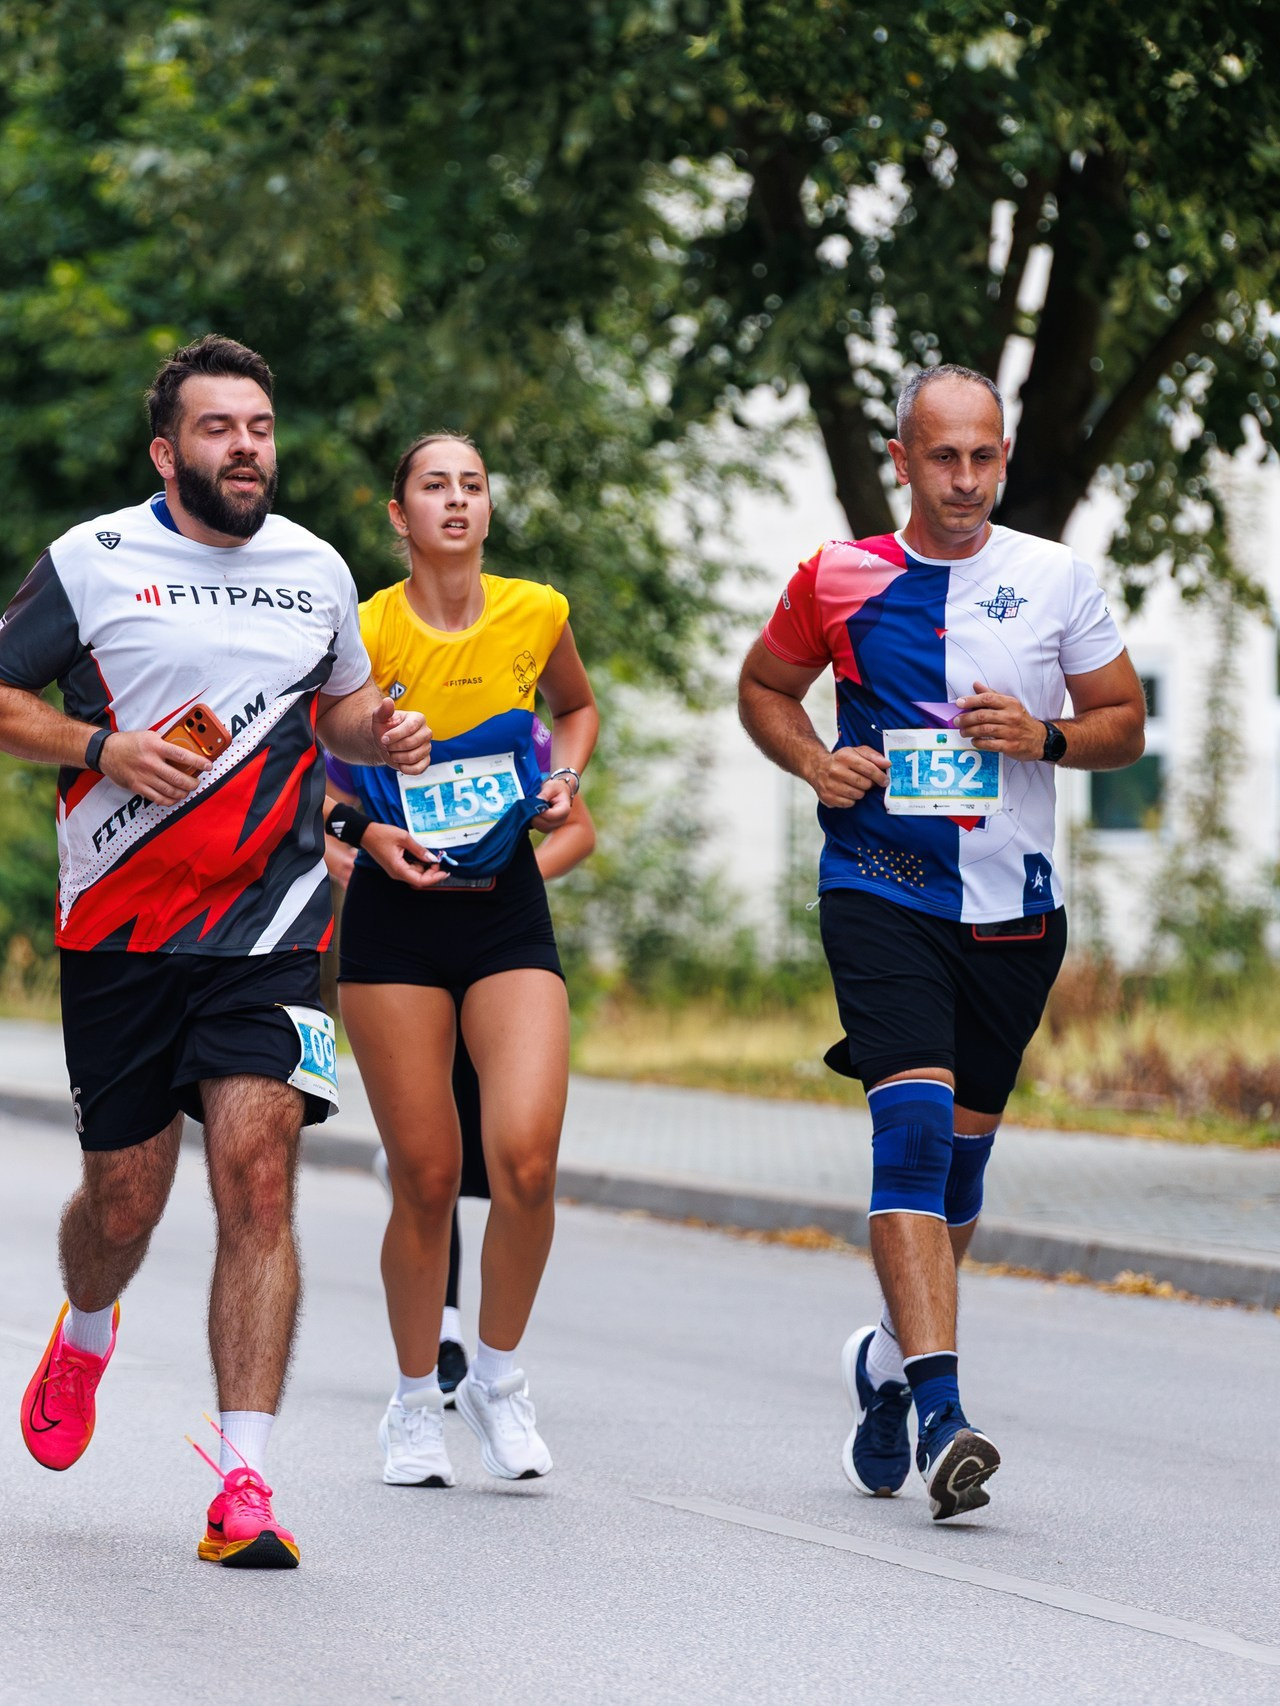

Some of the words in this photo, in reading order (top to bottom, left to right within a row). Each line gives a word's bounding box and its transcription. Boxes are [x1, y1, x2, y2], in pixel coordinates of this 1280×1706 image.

[166, 584, 314, 614] FITPASS
[449, 676, 483, 688] FITPASS
[904, 750, 984, 789] 152
[424, 775, 505, 822] 153
[91, 791, 154, 854] FITP
